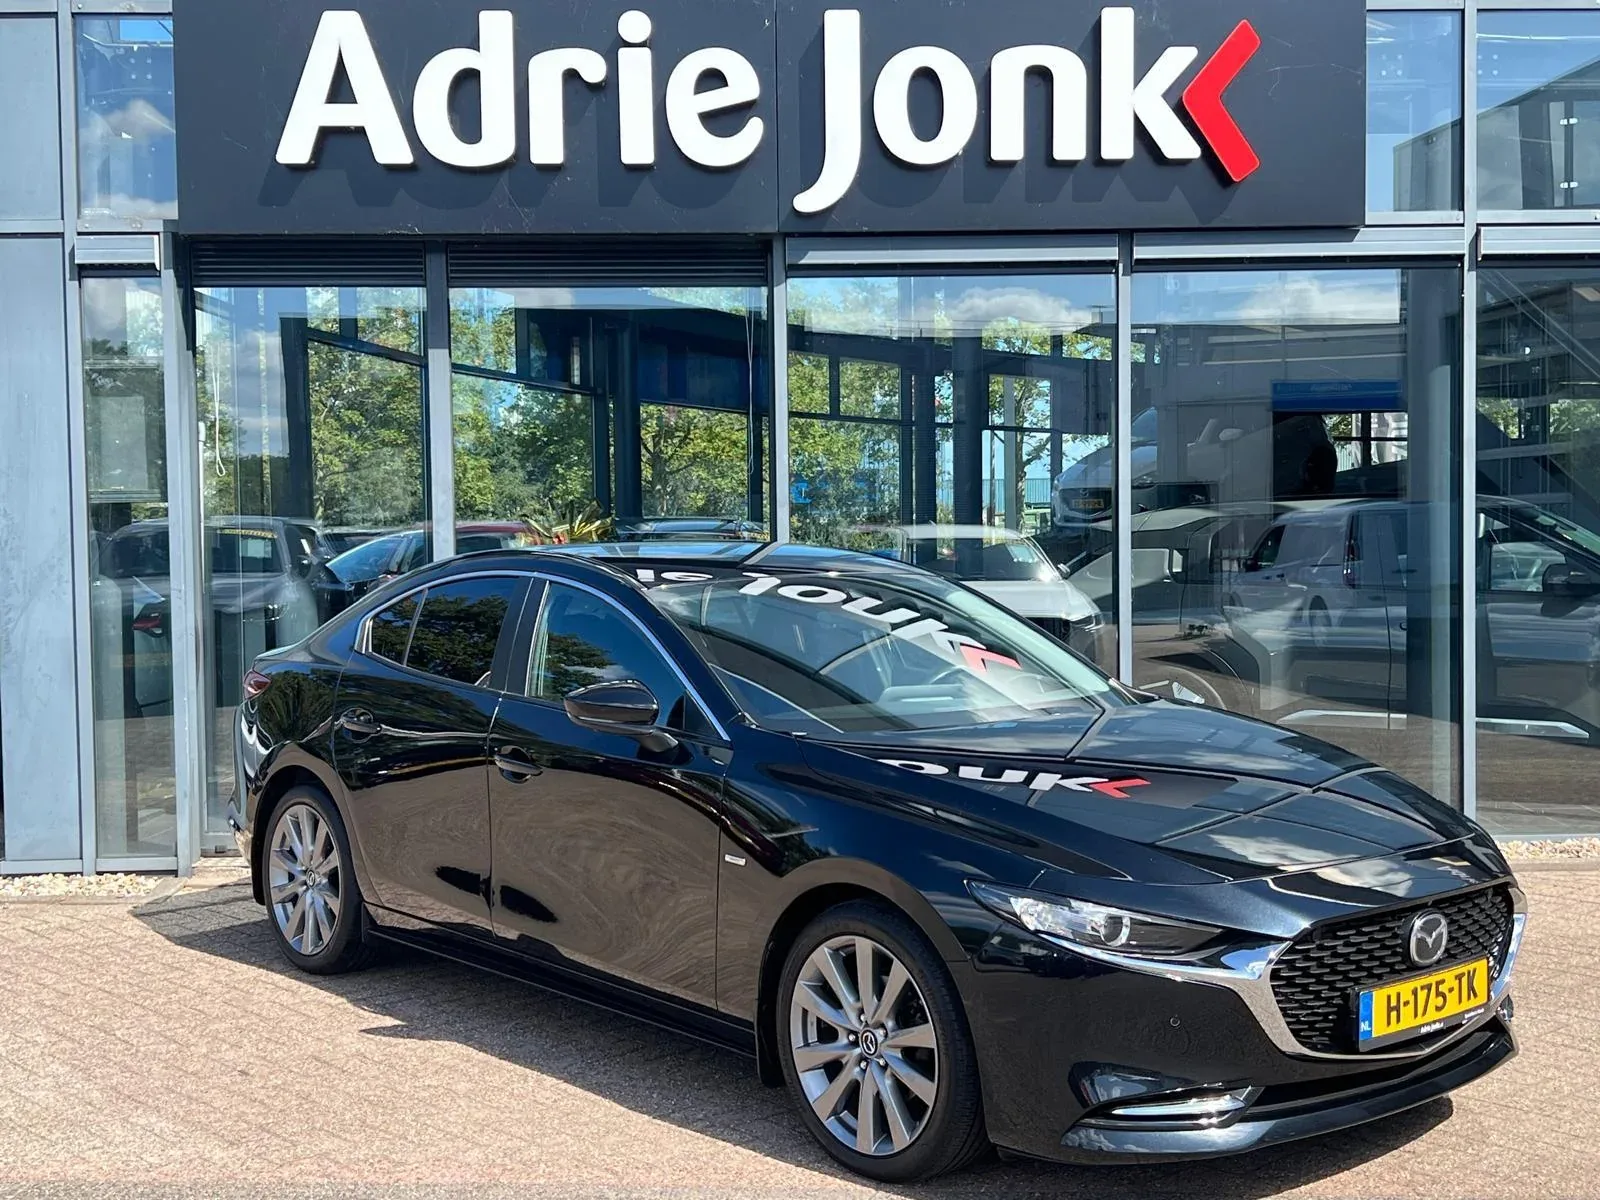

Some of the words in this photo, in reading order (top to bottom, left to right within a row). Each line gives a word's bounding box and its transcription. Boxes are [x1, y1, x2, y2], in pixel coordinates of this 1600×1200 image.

[275, 10, 764, 168] Adrie
[793, 6, 1203, 214] Jonk
[1360, 1020, 1372, 1033] NL
[1385, 967, 1479, 1028] H-175-TK
